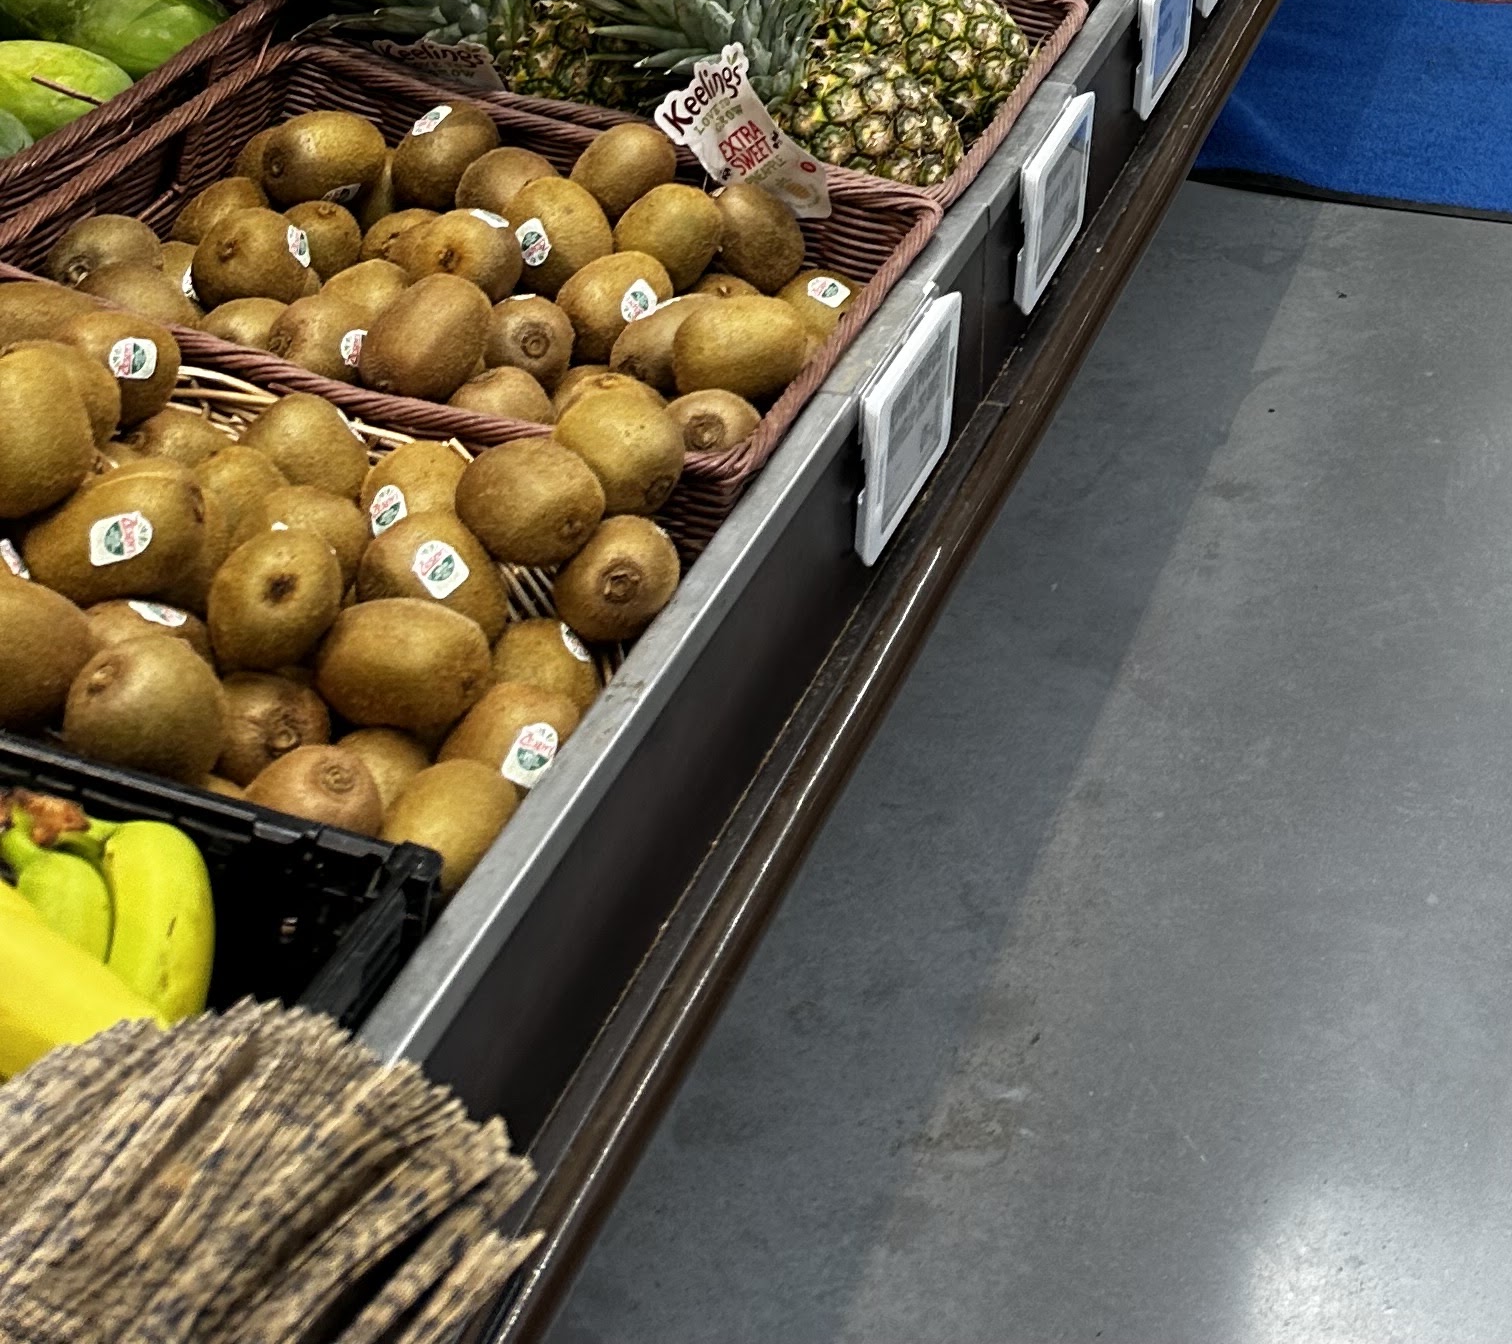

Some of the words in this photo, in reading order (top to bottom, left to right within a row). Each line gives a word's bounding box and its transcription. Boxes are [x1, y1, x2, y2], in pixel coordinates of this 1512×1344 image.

[663, 63, 743, 137] Keelings
[693, 103, 720, 136] LOVE
[714, 103, 744, 134] GROW
[718, 119, 765, 162] EXTRA
[730, 136, 774, 177] SWEET
